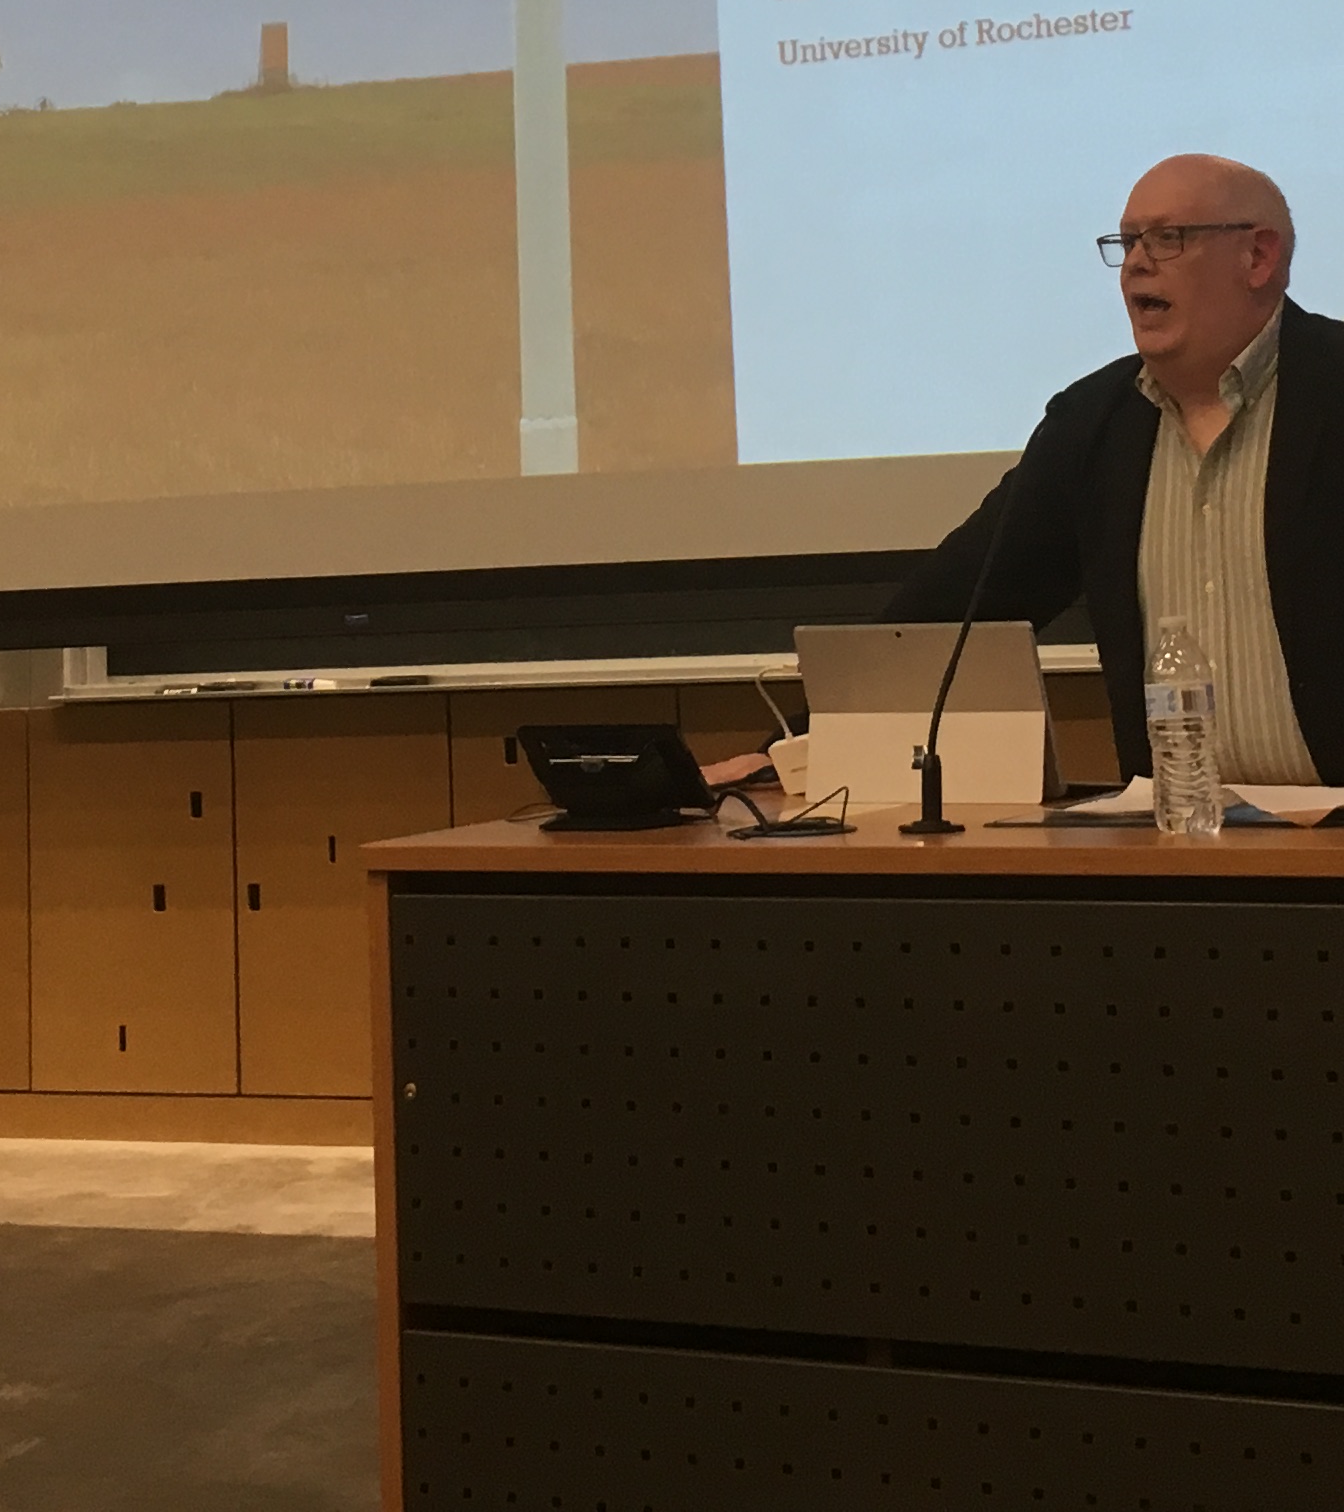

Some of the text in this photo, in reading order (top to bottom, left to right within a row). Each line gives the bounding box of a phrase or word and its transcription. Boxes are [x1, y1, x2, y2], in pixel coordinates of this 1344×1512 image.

[777, 9, 1134, 65] University of Rochester
